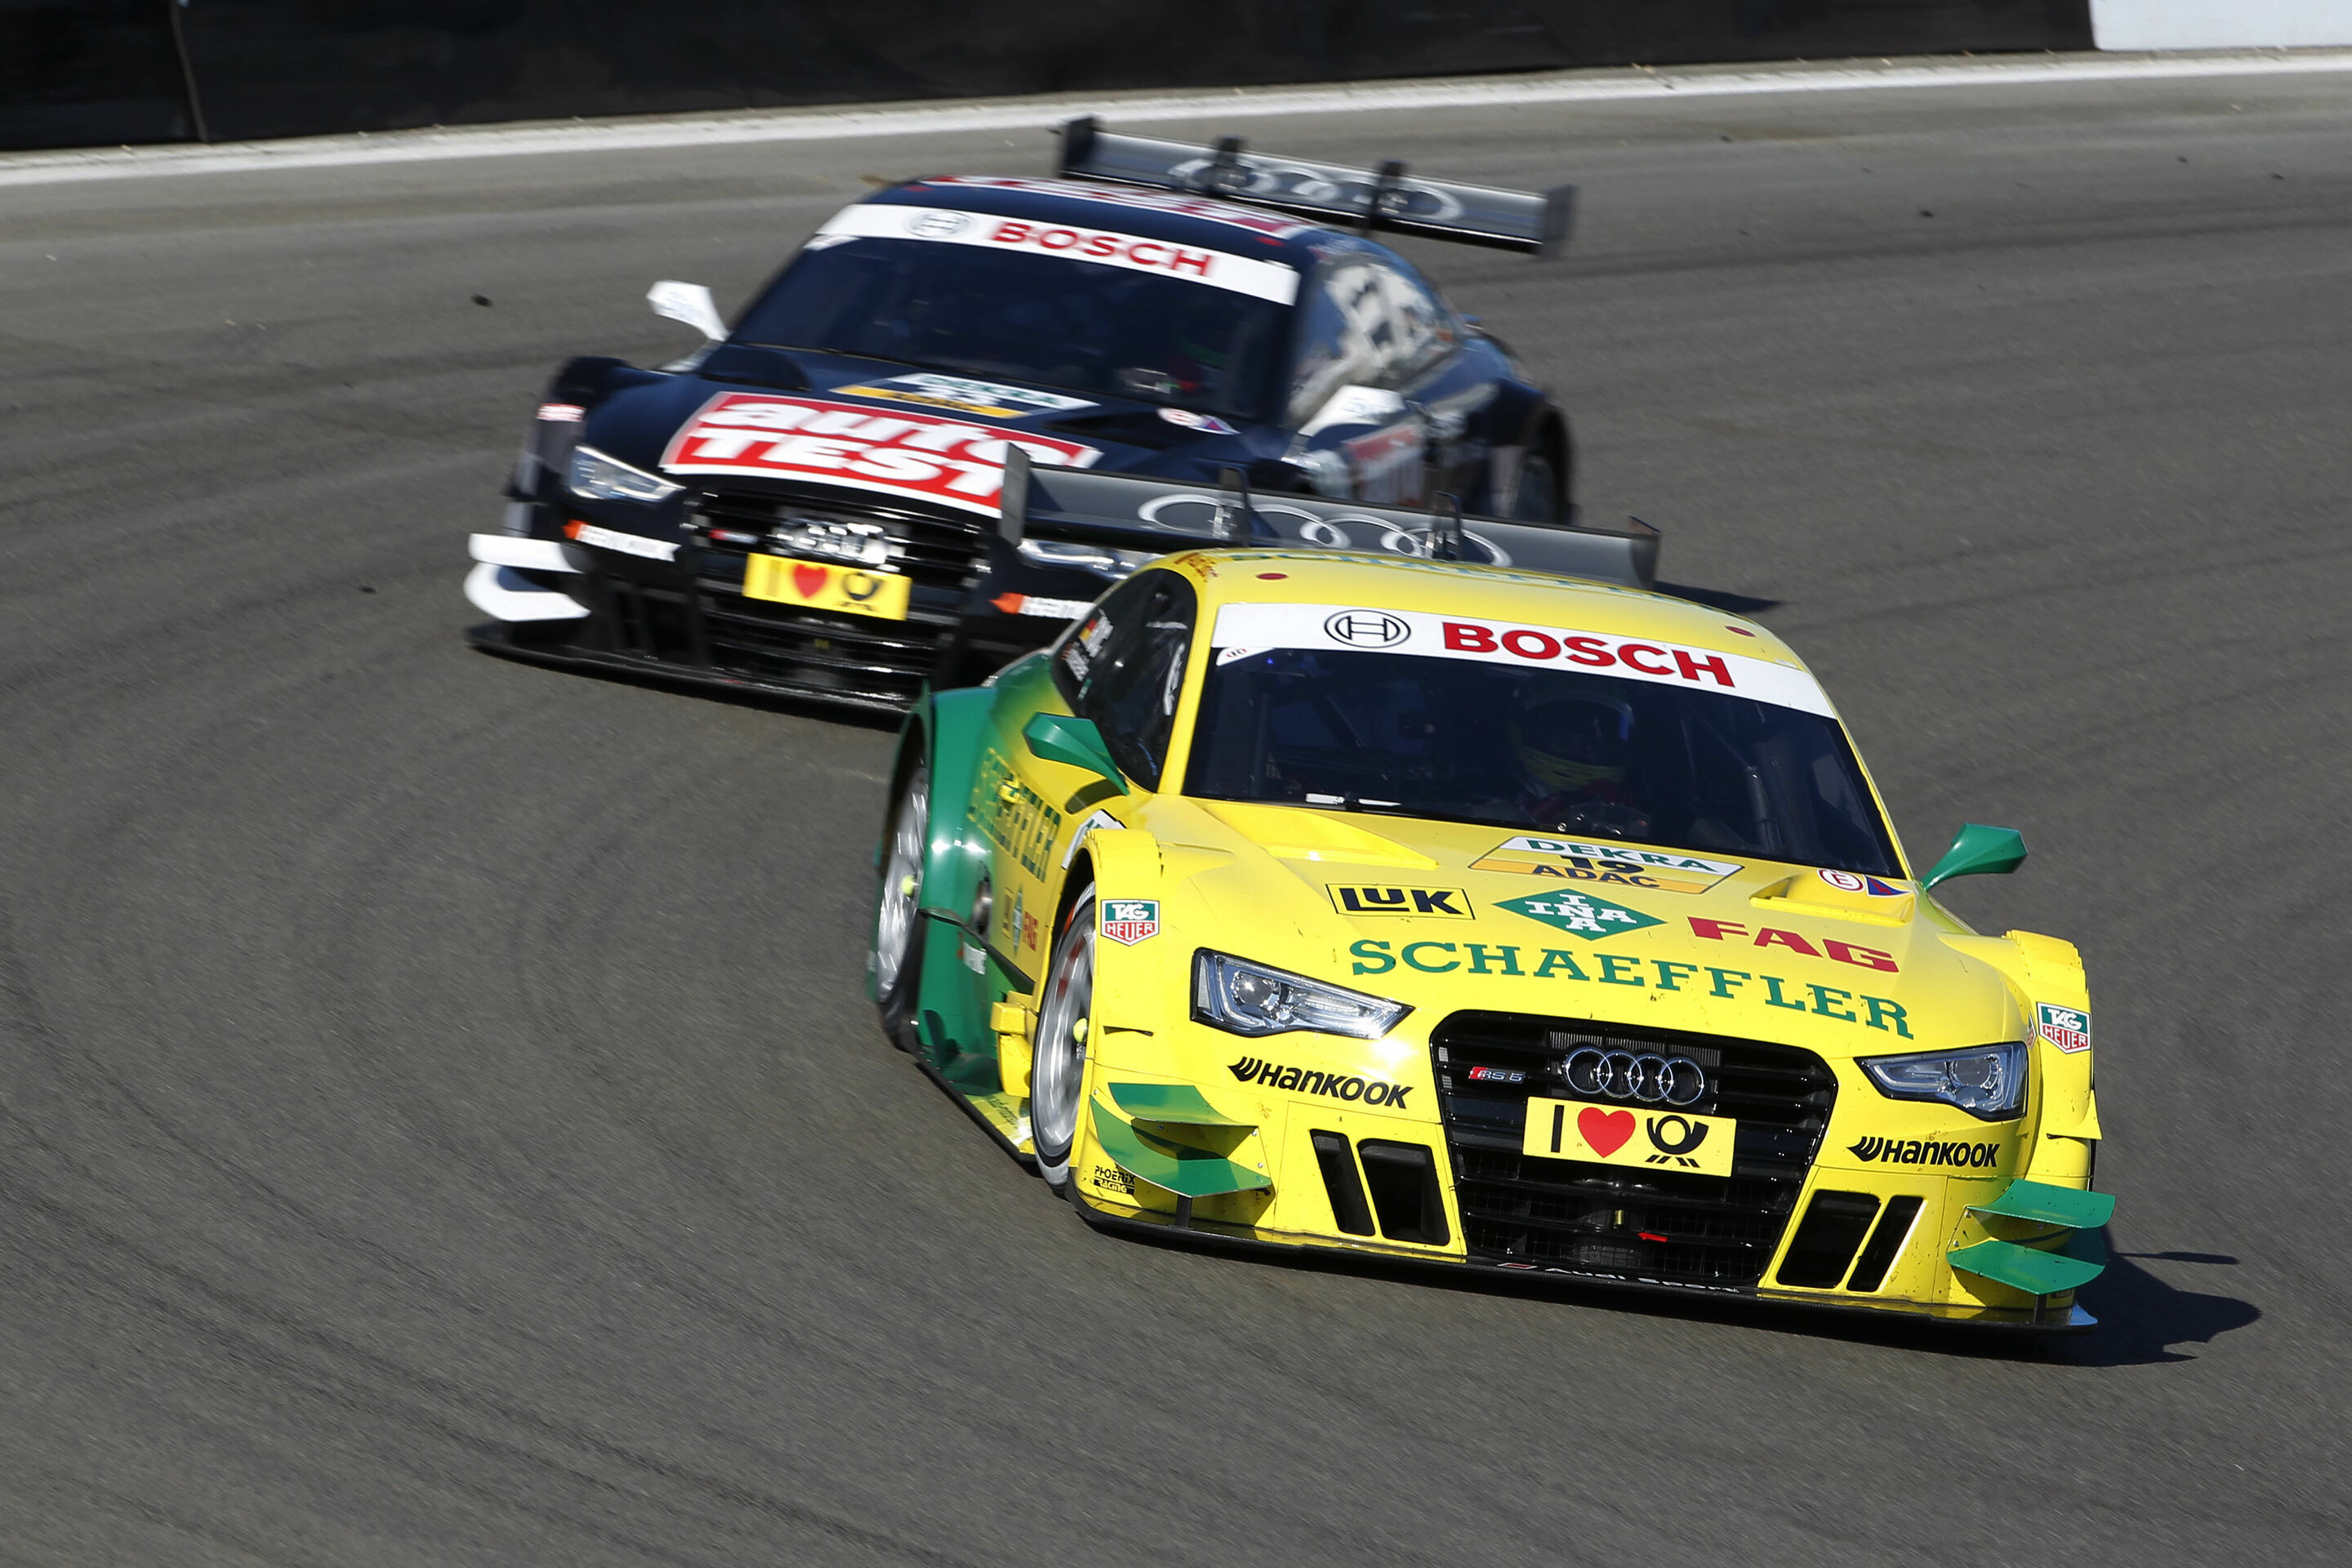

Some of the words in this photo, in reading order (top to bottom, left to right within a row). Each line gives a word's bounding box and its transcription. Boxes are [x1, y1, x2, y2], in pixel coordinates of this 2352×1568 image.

[990, 220, 1216, 278] BOSCH
[688, 426, 1004, 497] TEST
[1442, 621, 1735, 688] BOSCH
[1524, 839, 1718, 873] DEKRA
[1532, 864, 1661, 889] ADAC
[1106, 923, 1154, 942] HEUER
[1111, 903, 1150, 921] TAG
[1687, 915, 1900, 973] FAG
[1349, 939, 1915, 1040] SCHAEFFLER
[2044, 1026, 2087, 1049] HEUER
[2047, 1008, 2082, 1031] TAG
[1550, 1104, 1565, 1153] I
